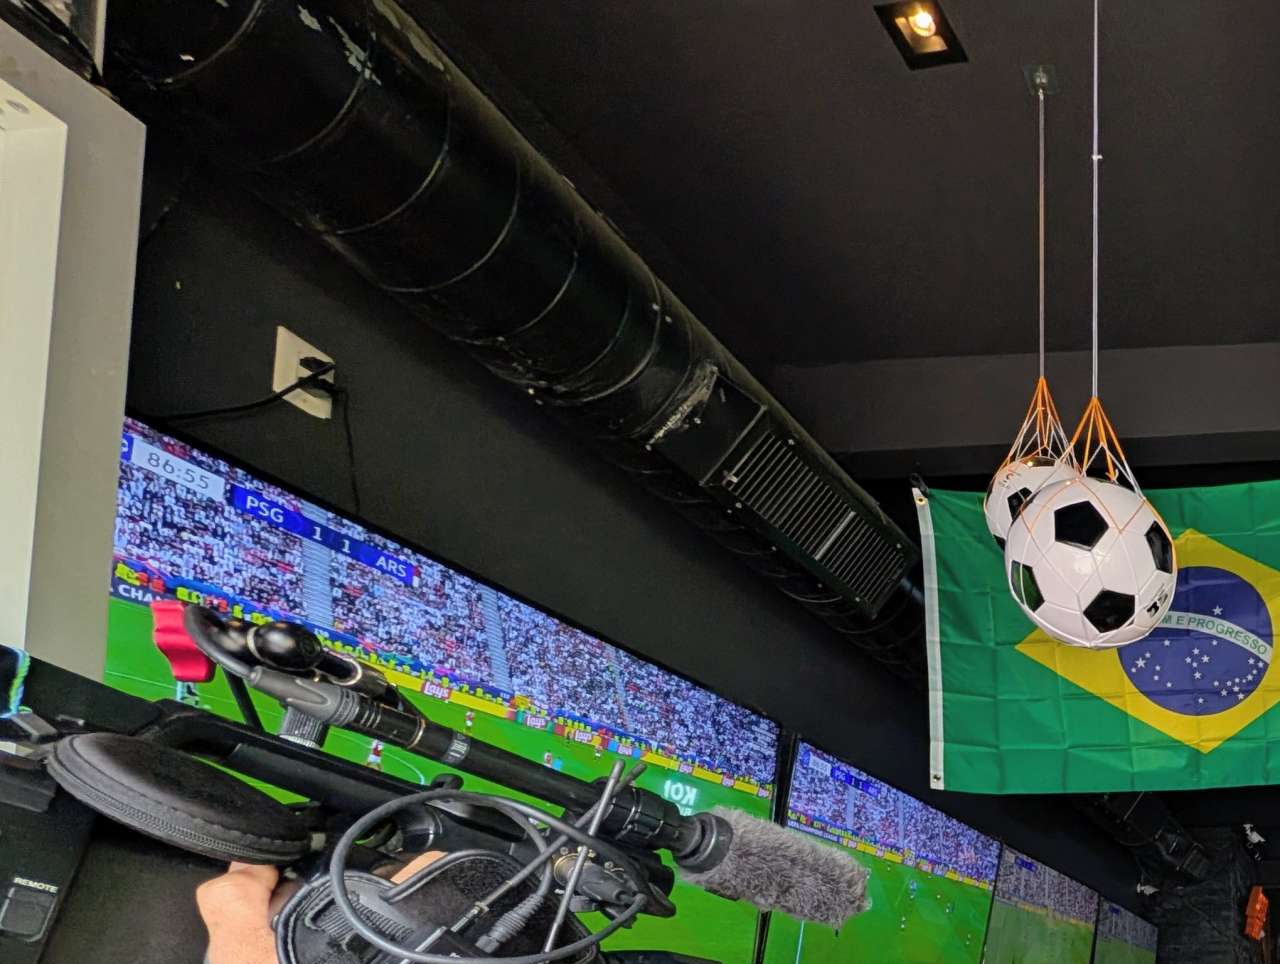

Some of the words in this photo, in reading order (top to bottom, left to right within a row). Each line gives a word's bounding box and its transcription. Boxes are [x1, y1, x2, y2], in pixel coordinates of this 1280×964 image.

[147, 451, 210, 490] 86:55
[246, 495, 285, 524] PSG
[312, 526, 322, 541] 1
[343, 539, 351, 554] 1
[376, 556, 408, 578] ARS
[1176, 616, 1185, 625] E
[1187, 616, 1268, 655] PROGRESSO
[13, 877, 59, 894] REMOTE
